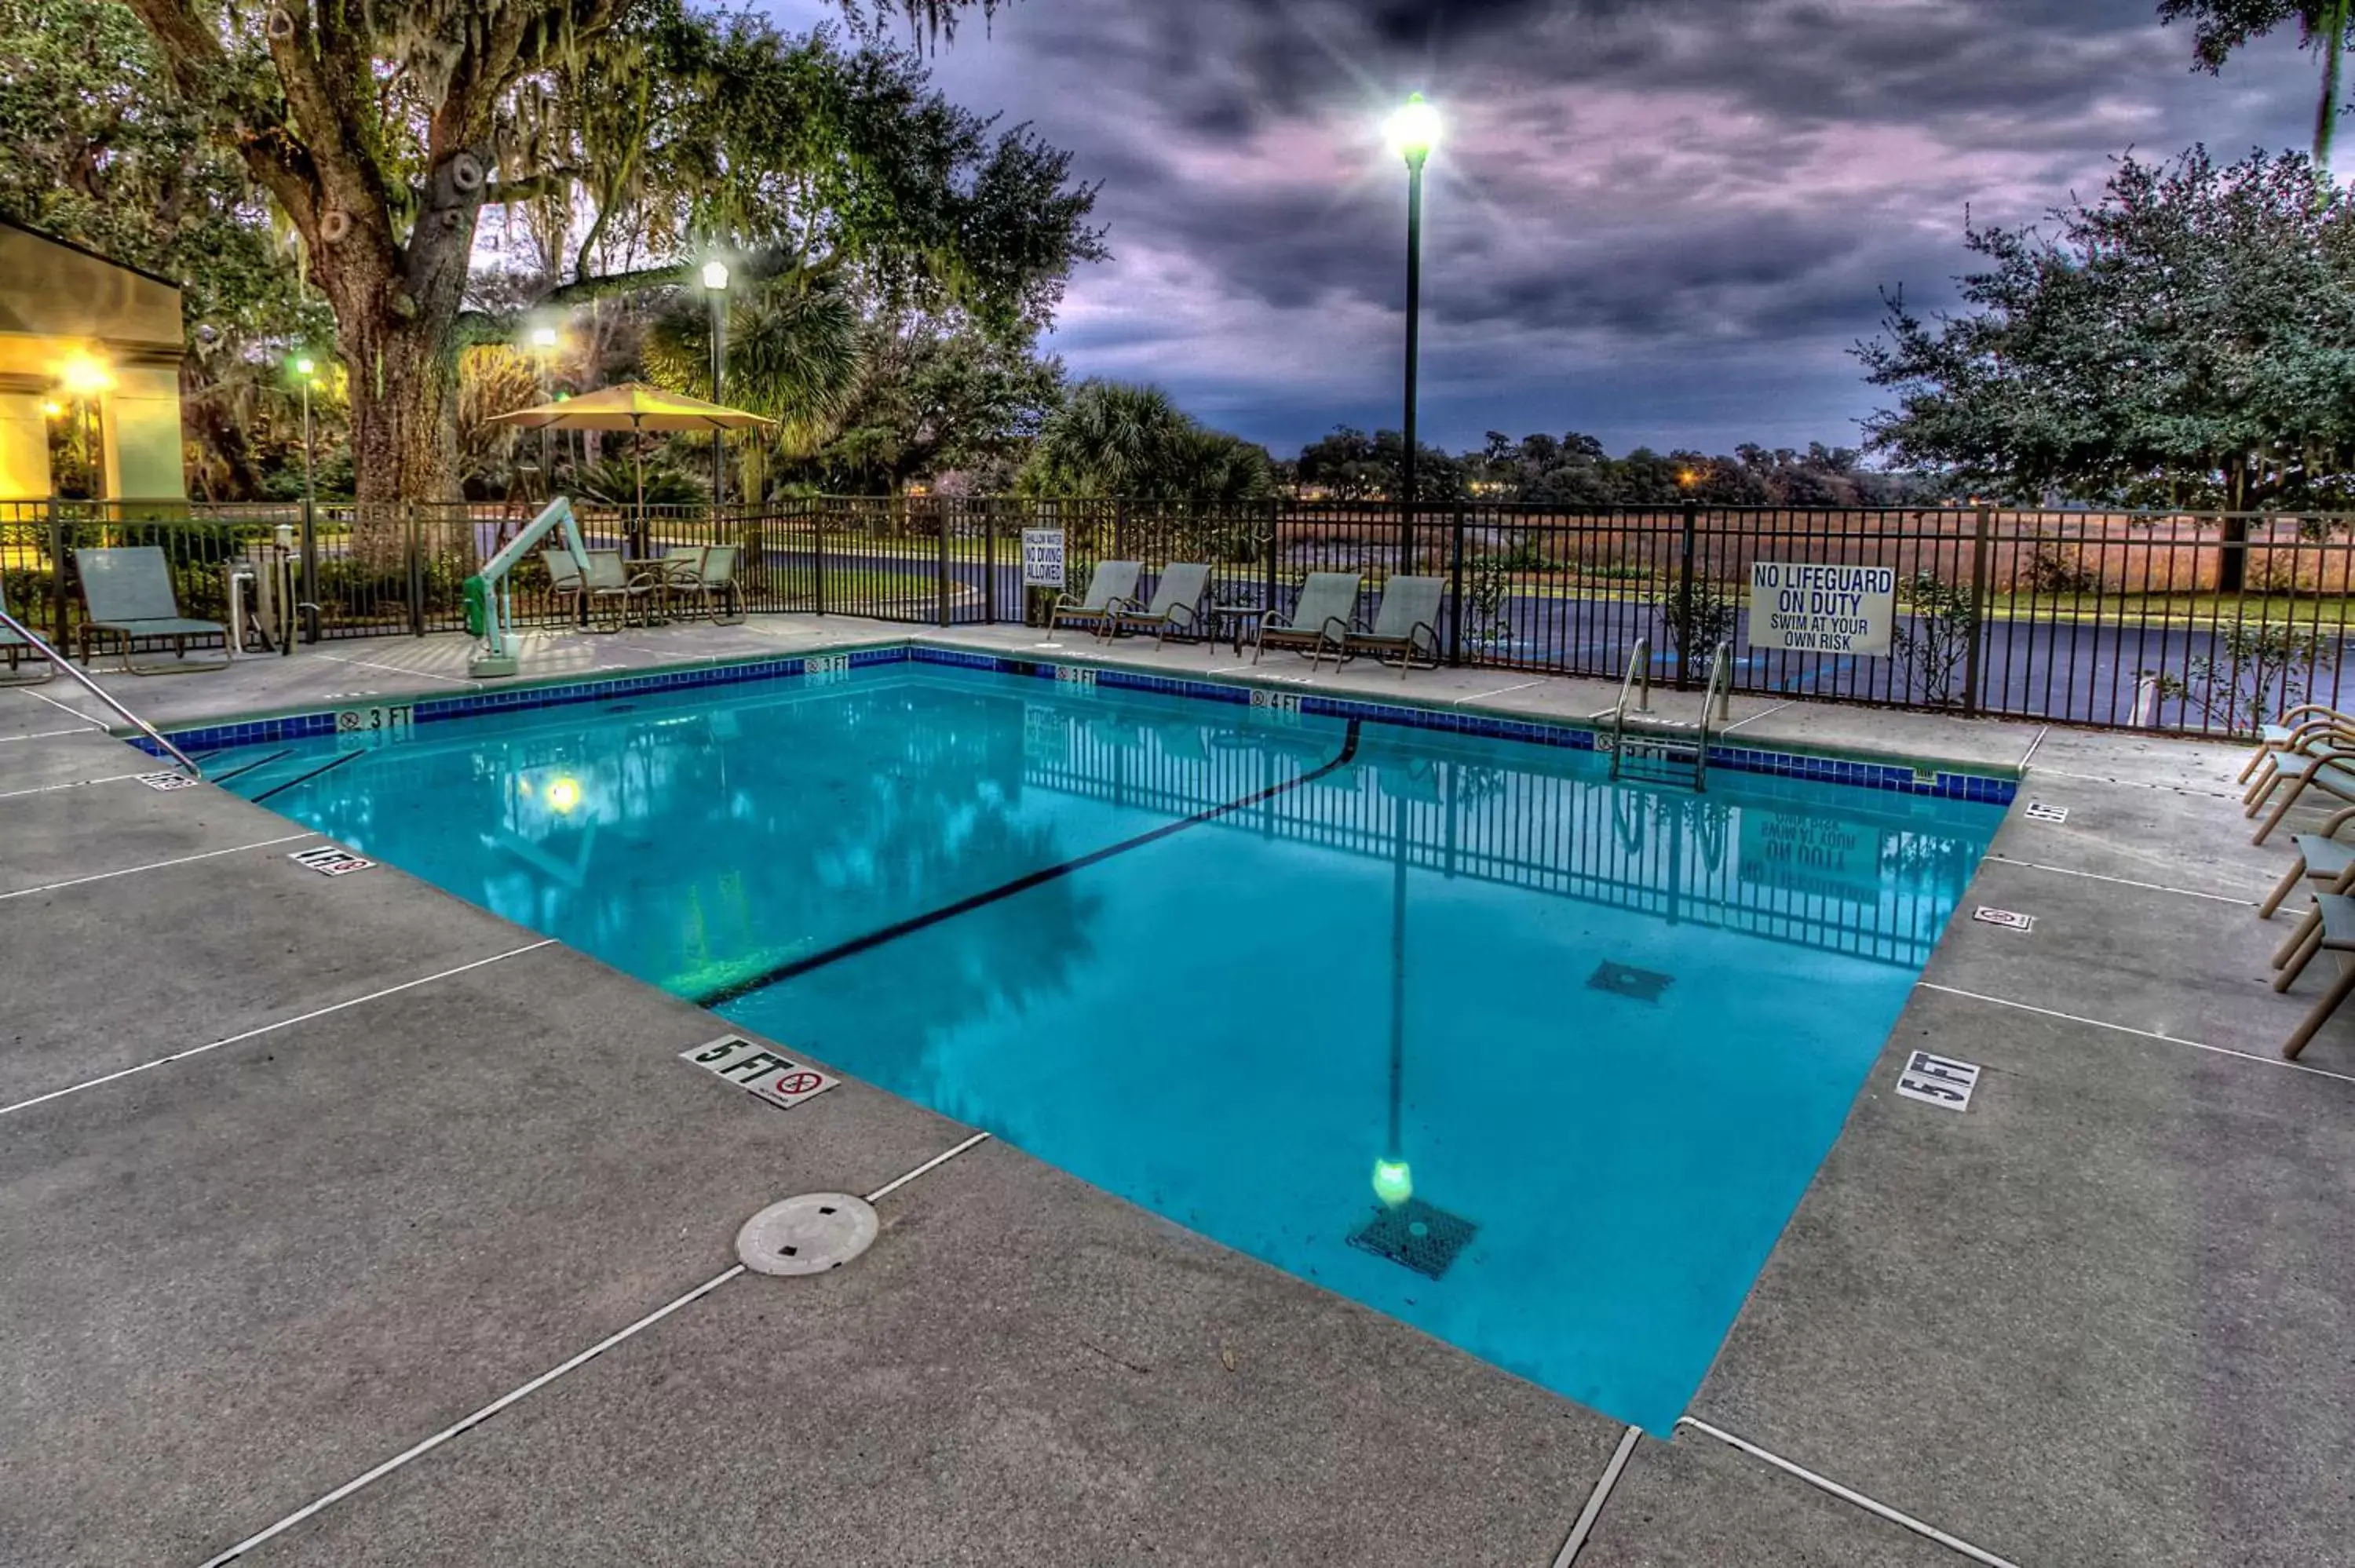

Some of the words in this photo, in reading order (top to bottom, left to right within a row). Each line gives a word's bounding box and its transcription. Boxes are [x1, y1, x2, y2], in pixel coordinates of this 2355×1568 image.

[1026, 547, 1035, 562] NO
[1038, 547, 1062, 563] DIVING
[1027, 563, 1061, 580] ALLOWED
[1754, 565, 1779, 588] NO
[1786, 567, 1892, 594] LIFEGUARD
[1780, 590, 1804, 613] ON
[1812, 593, 1861, 616] DUTY
[1771, 614, 1807, 631] SWIM
[1811, 617, 1826, 632] AT
[1831, 618, 1868, 636] YOUR
[1784, 631, 1816, 648] OWN
[1820, 633, 1851, 651] RISK
[1083, 669, 1095, 685] FT
[1271, 693, 1279, 709] 4
[1283, 695, 1299, 714] FT
[371, 709, 382, 728] 3
[389, 706, 411, 727] FT
[695, 1039, 750, 1063] 5
[719, 1052, 795, 1084] FT
[1911, 1052, 1975, 1085] FT
[1900, 1078, 1965, 1102] 5
